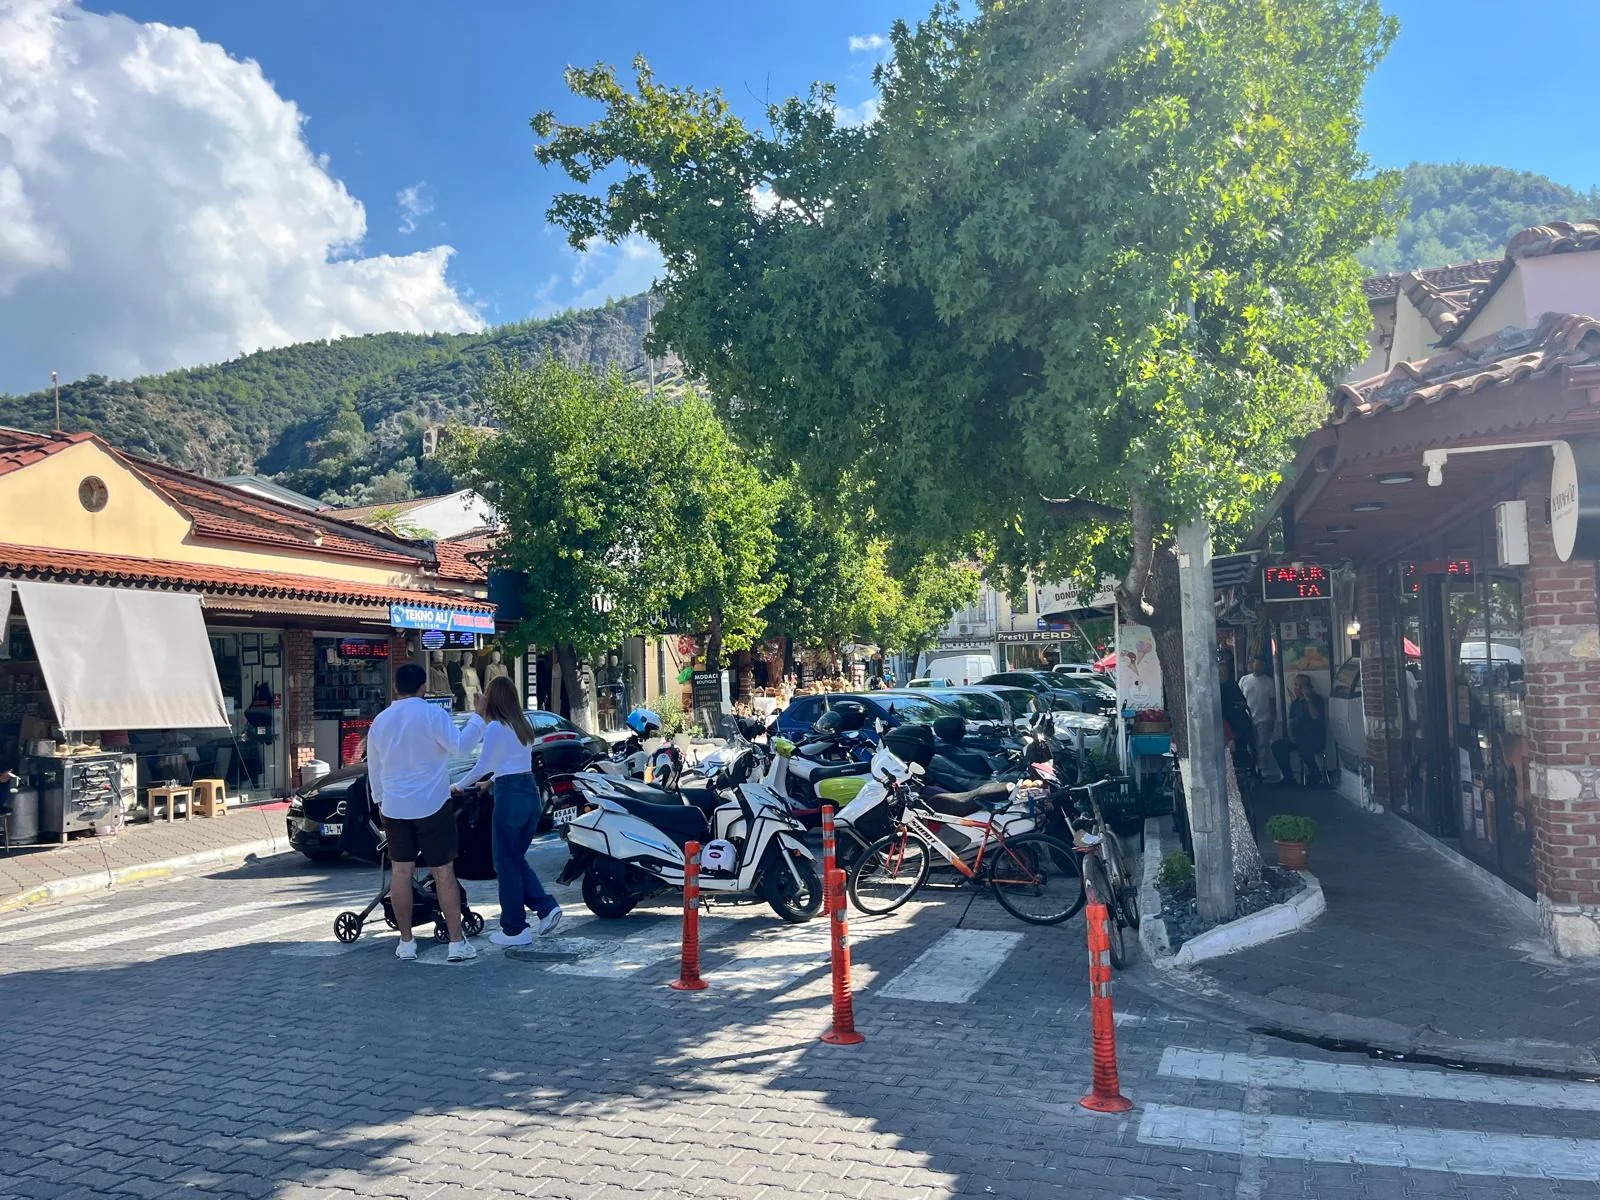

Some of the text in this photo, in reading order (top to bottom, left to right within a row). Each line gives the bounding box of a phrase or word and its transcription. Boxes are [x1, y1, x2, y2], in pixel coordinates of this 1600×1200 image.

[405, 608, 432, 622] TEKNO
[998, 632, 1029, 642] Prestij
[324, 825, 334, 834] 34
